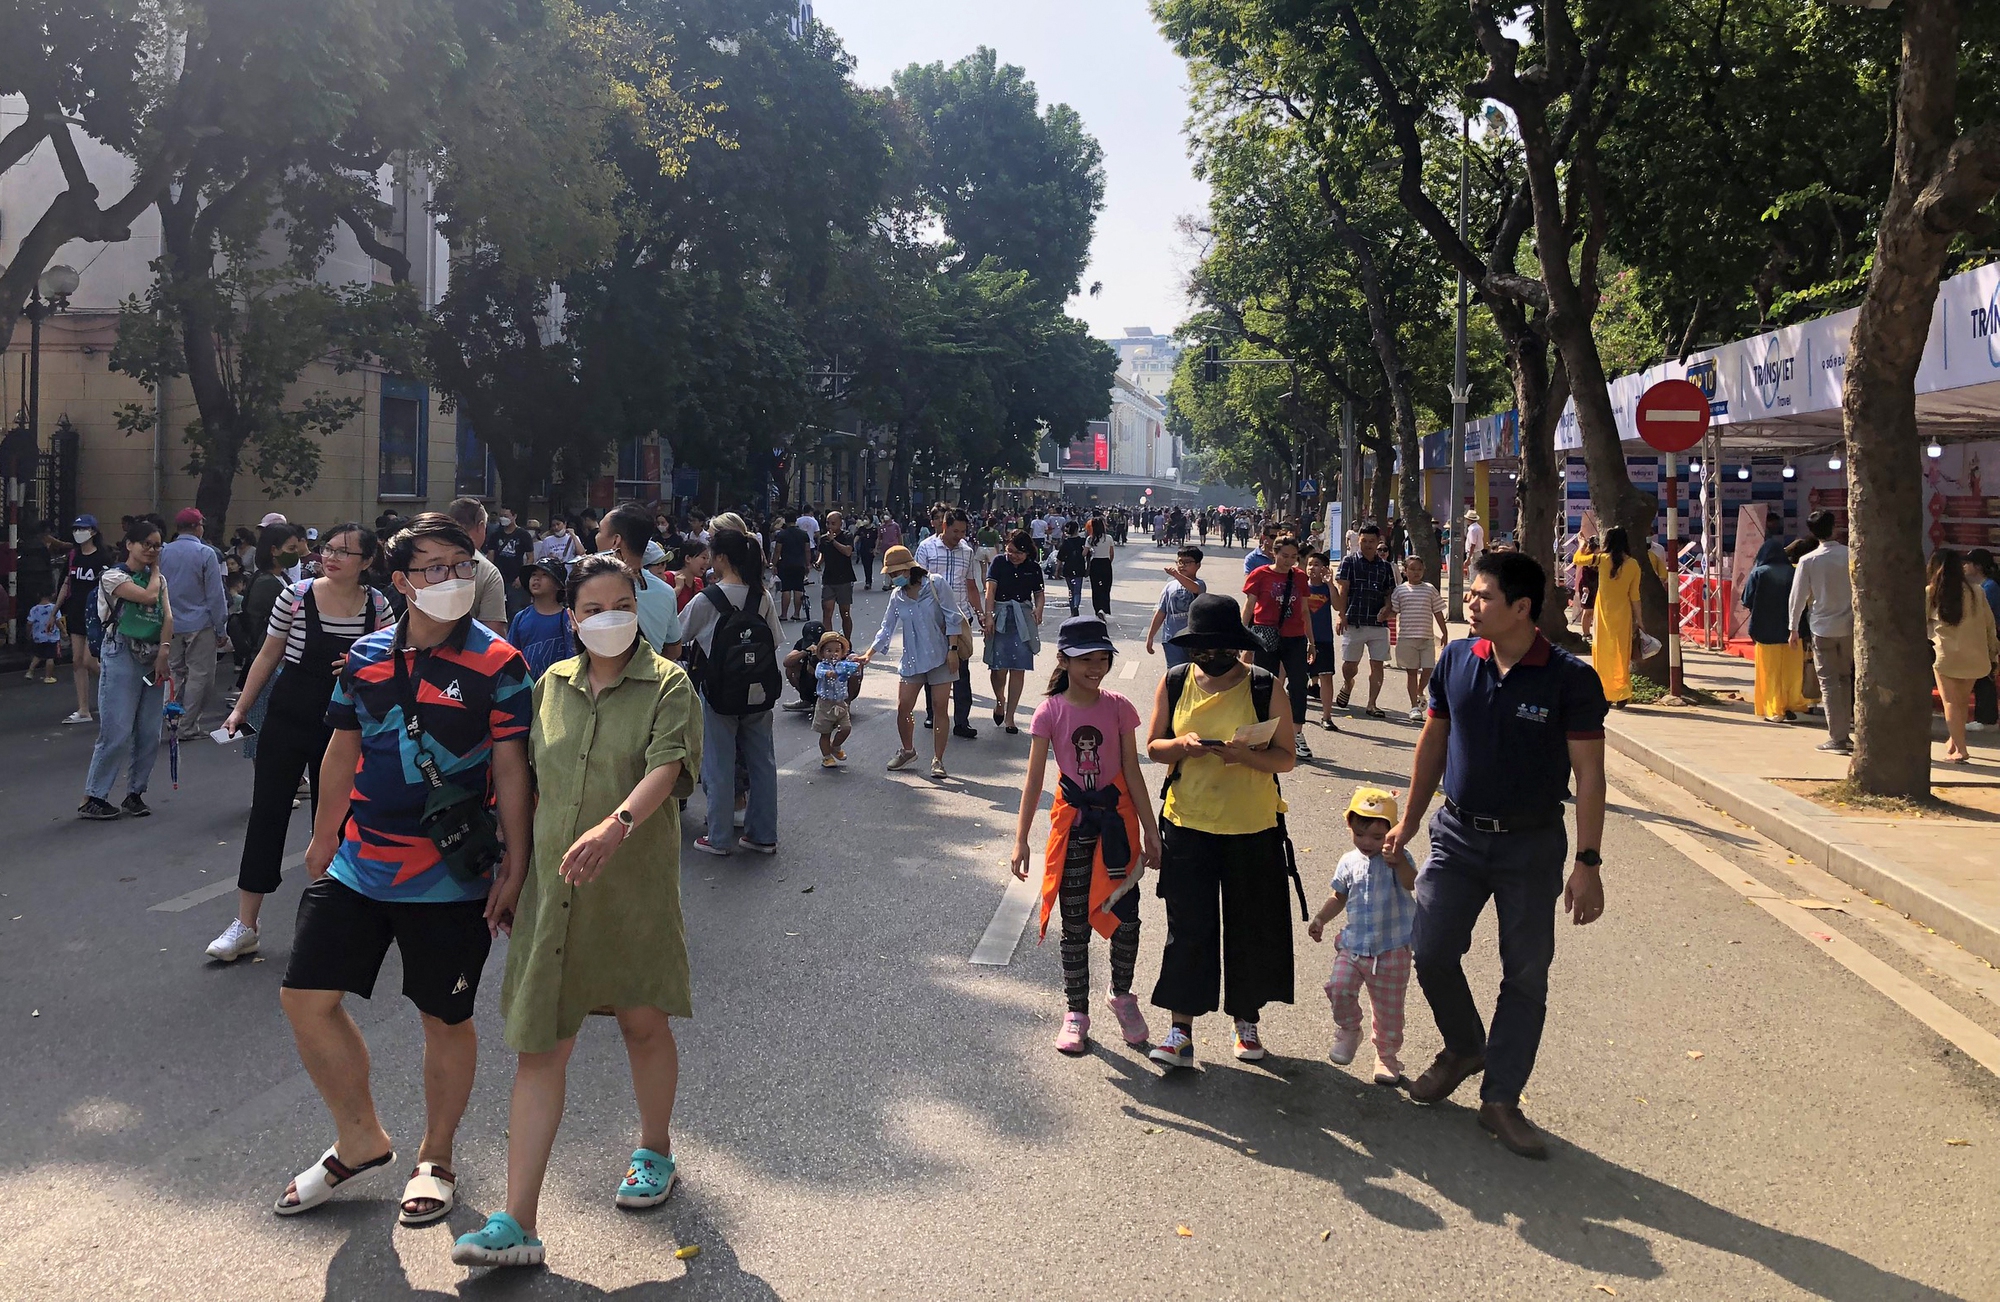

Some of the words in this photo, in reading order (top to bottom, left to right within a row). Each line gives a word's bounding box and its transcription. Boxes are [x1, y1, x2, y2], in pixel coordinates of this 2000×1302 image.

[1704, 370, 1714, 391] 10
[1753, 357, 1795, 387] TRANSVIET
[1777, 395, 1792, 407] Travel
[70, 566, 95, 581] FILA
